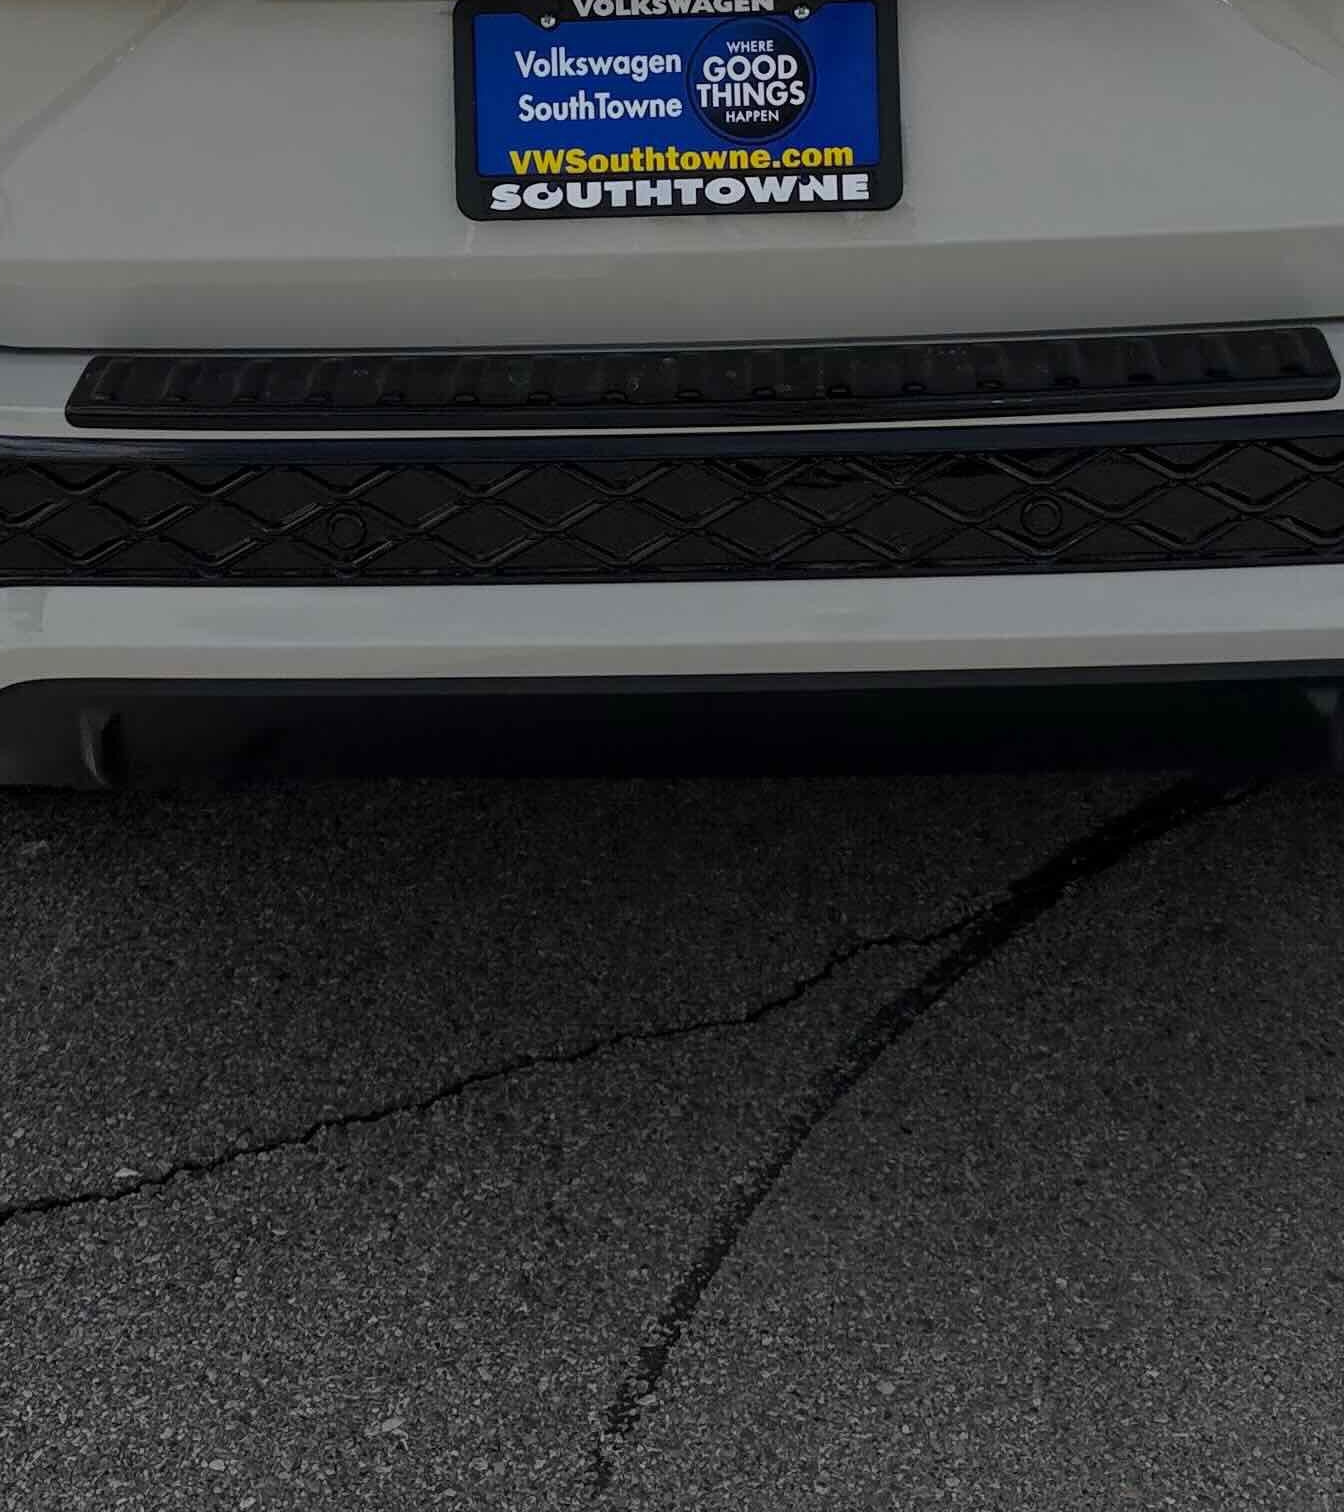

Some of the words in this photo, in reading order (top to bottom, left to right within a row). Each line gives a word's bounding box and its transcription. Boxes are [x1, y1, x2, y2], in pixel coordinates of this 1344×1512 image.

[726, 39, 774, 54] WHERE
[514, 46, 682, 82] Volkswagen
[702, 54, 798, 83] GOOD
[517, 89, 683, 122] SouthTowne
[695, 80, 806, 108] THINGS
[725, 108, 780, 124] HAPPEN
[509, 146, 855, 176] VWSouthtowne.com
[490, 173, 870, 211] SOUTHTOWNE
